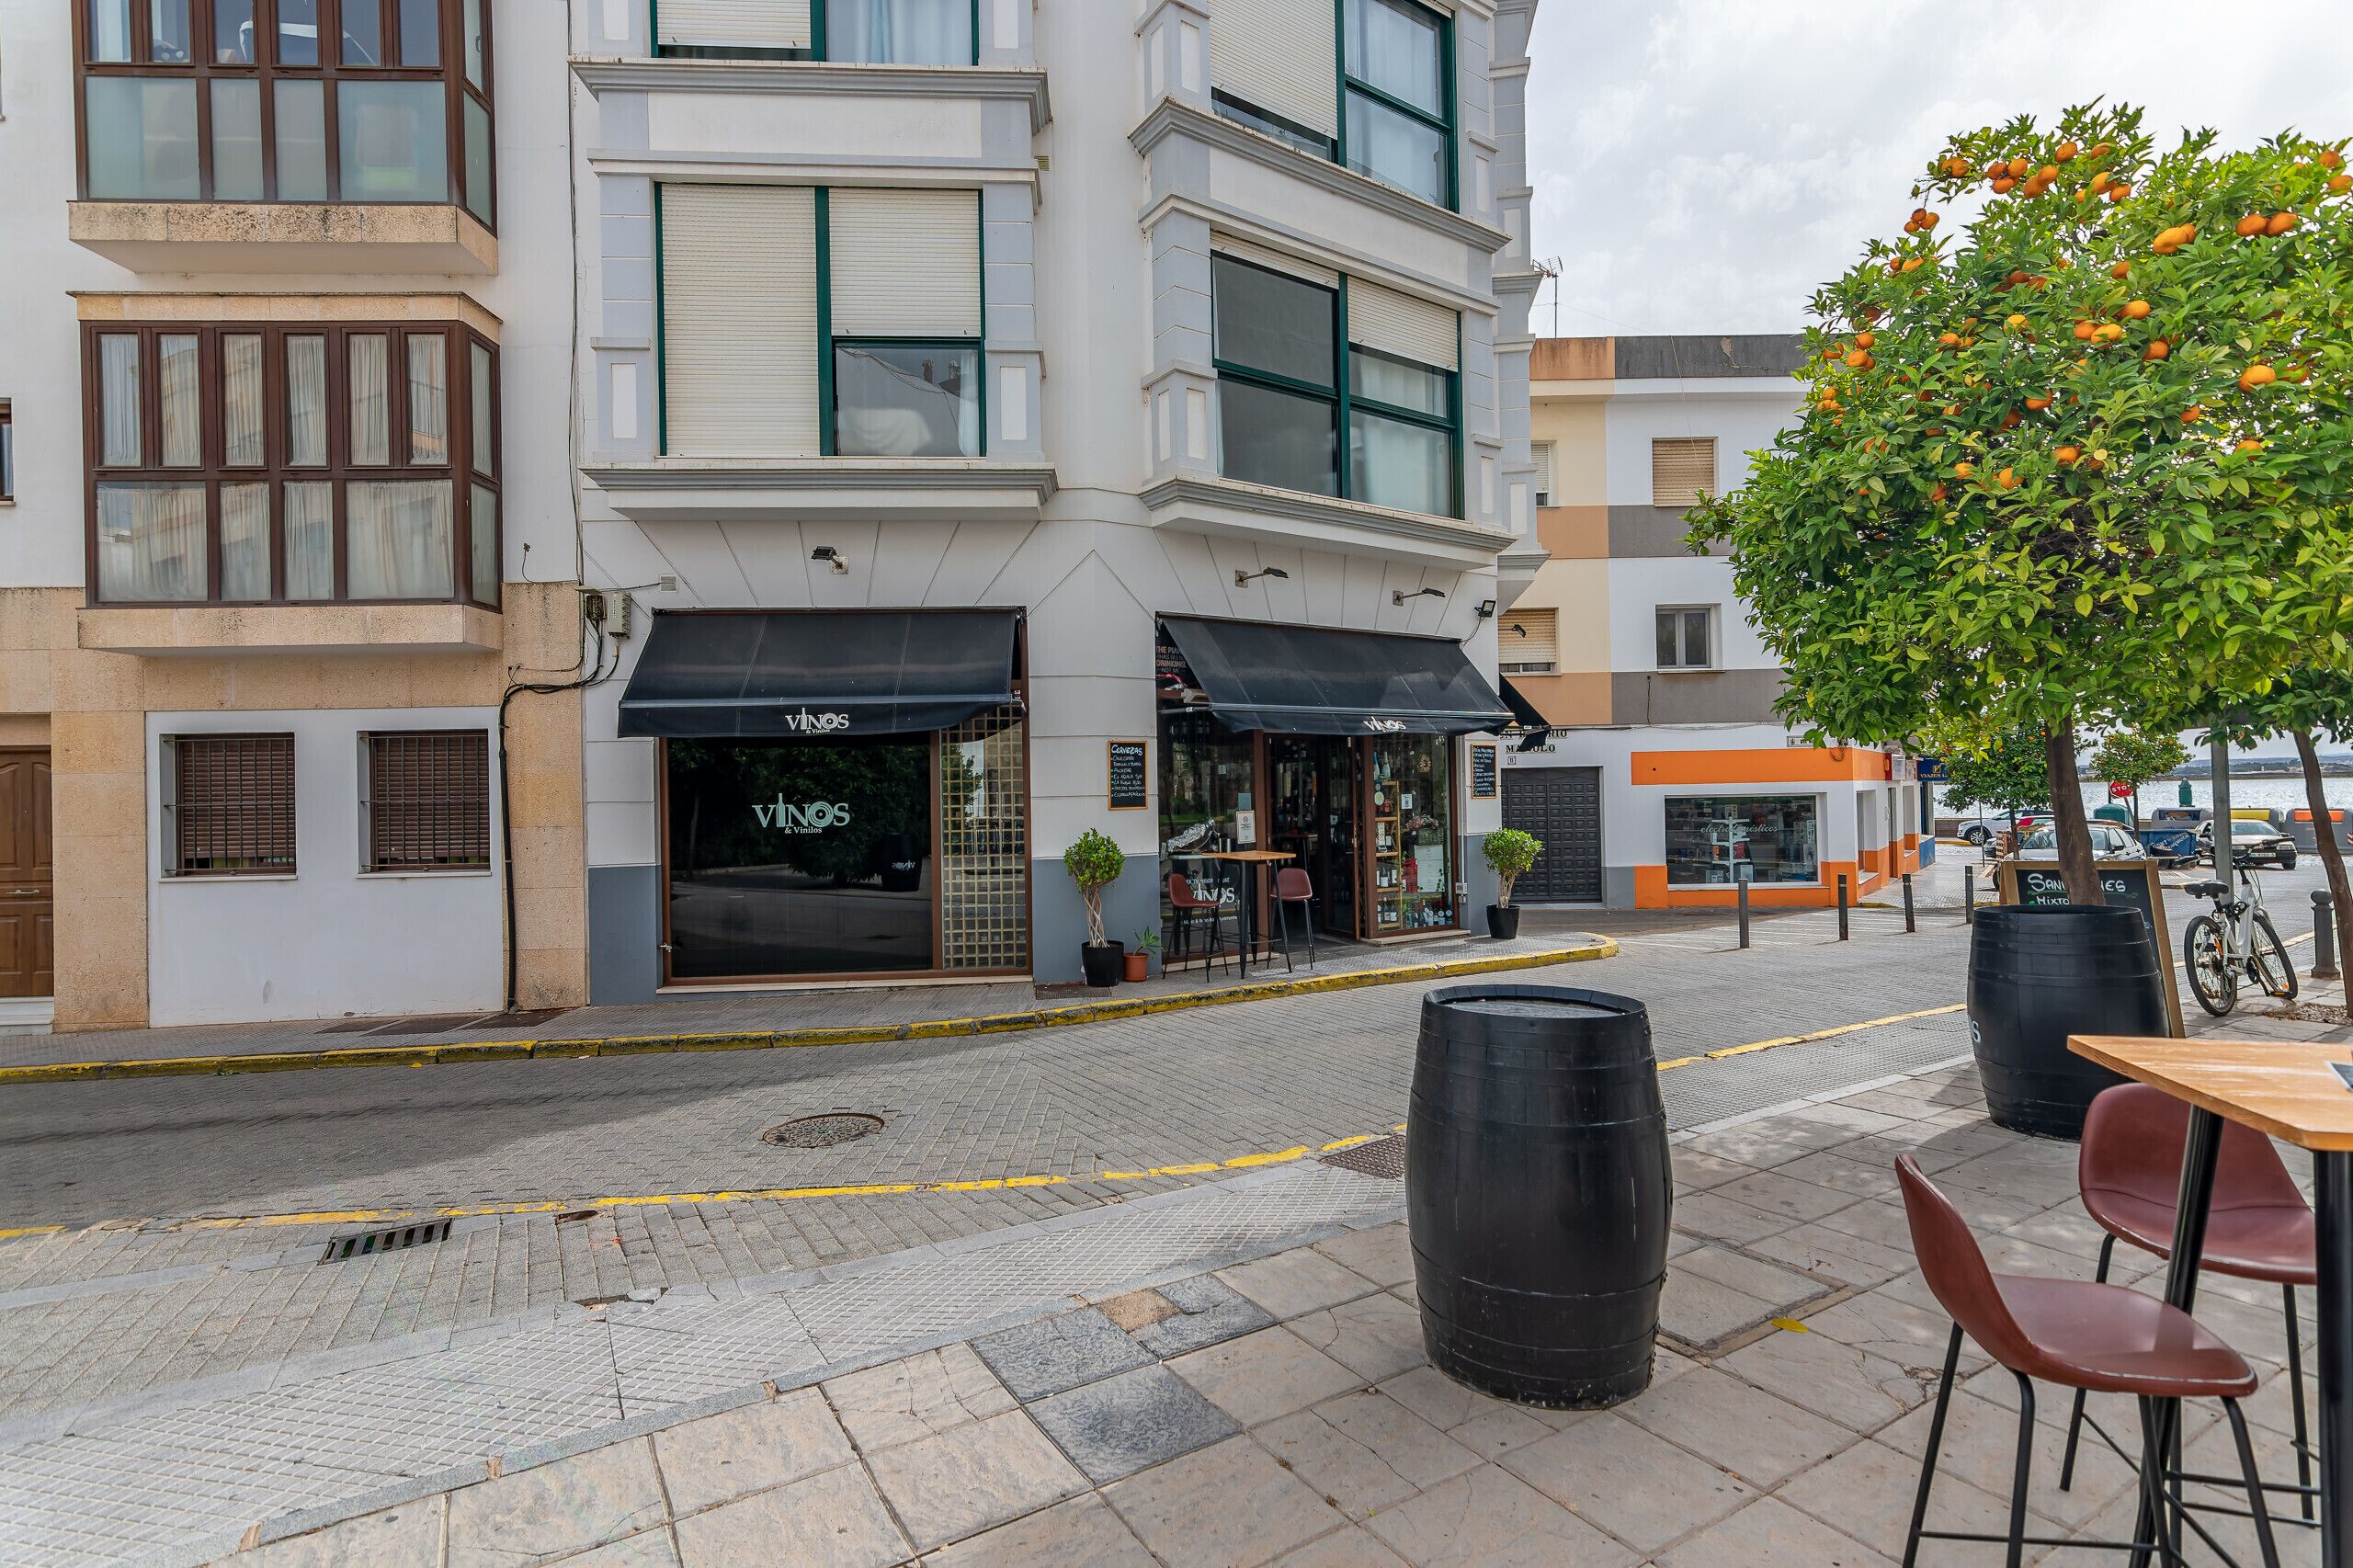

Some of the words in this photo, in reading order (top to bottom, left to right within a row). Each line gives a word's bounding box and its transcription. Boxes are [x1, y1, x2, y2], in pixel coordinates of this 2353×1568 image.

[785, 708, 849, 730] VINOS
[1363, 716, 1406, 732] VINOS
[2111, 784, 2131, 792] STO
[752, 793, 850, 827] VINOS
